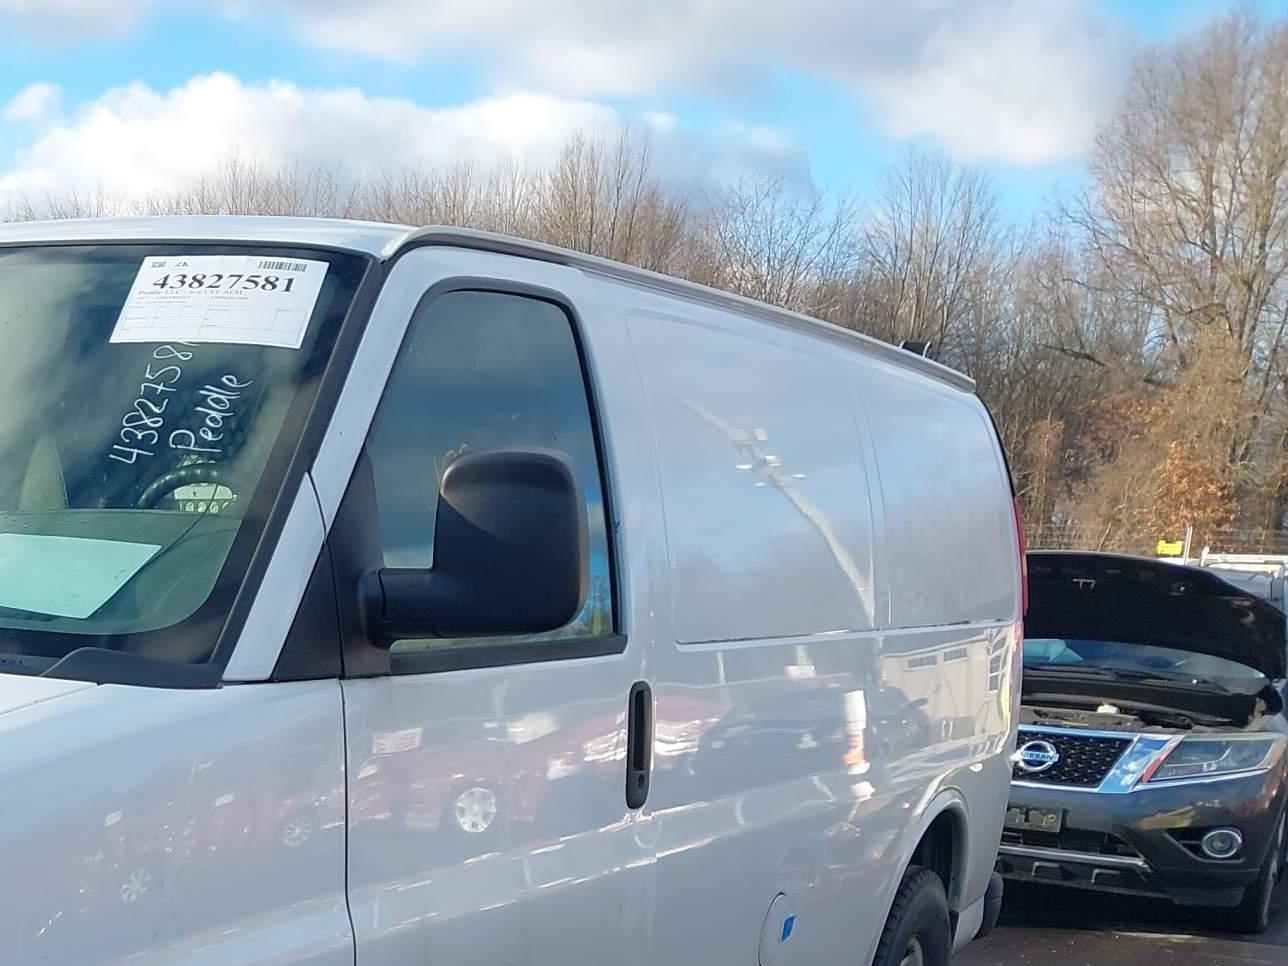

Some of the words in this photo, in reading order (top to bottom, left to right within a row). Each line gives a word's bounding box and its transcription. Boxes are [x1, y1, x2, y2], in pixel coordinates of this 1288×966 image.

[152, 273, 295, 293] 43827581
[109, 341, 199, 464] 4382758
[169, 375, 253, 452] Peddle
[1022, 751, 1055, 760] NISSAN
